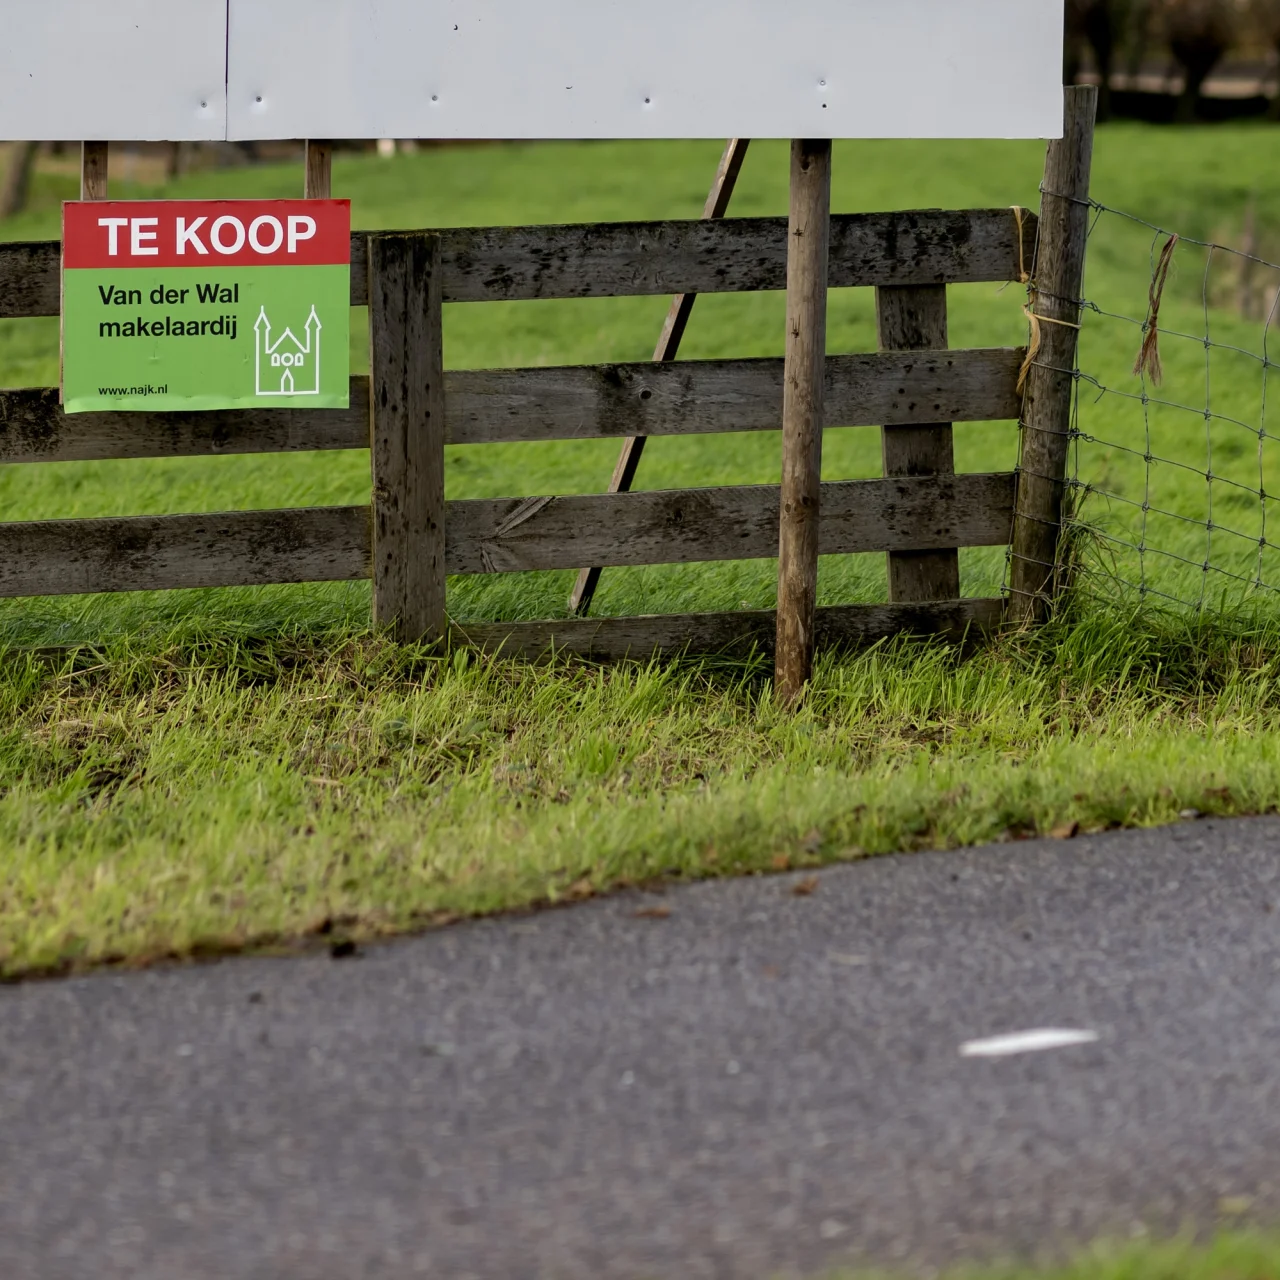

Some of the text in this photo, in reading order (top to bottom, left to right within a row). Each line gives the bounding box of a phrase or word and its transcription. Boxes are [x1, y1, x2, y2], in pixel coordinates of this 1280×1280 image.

[98, 215, 317, 256] TE KOOP
[98, 283, 239, 306] Van der Wal
[99, 315, 237, 340] makelaardij
[98, 383, 168, 397] www.najk.nl
